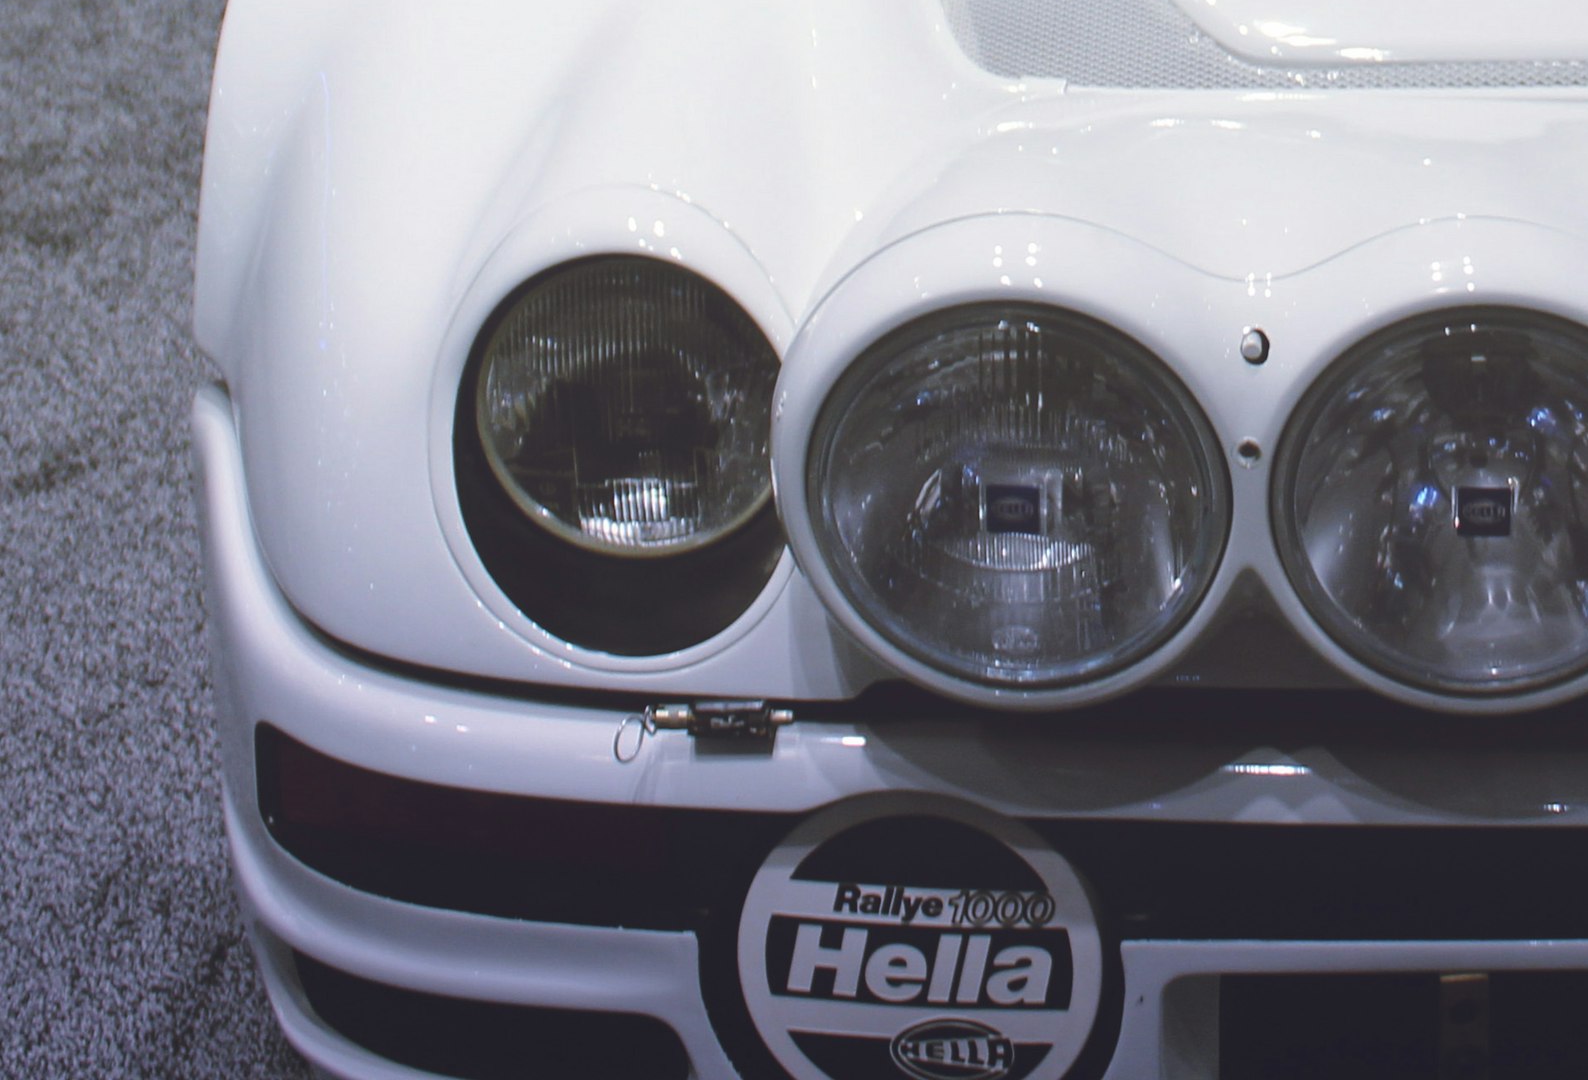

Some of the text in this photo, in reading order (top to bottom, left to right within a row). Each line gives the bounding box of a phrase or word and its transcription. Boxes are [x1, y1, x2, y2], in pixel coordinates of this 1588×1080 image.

[833, 883, 1056, 927] Rallye 1000
[787, 923, 1053, 1005] Hella
[900, 1035, 1013, 1072] HELLA
